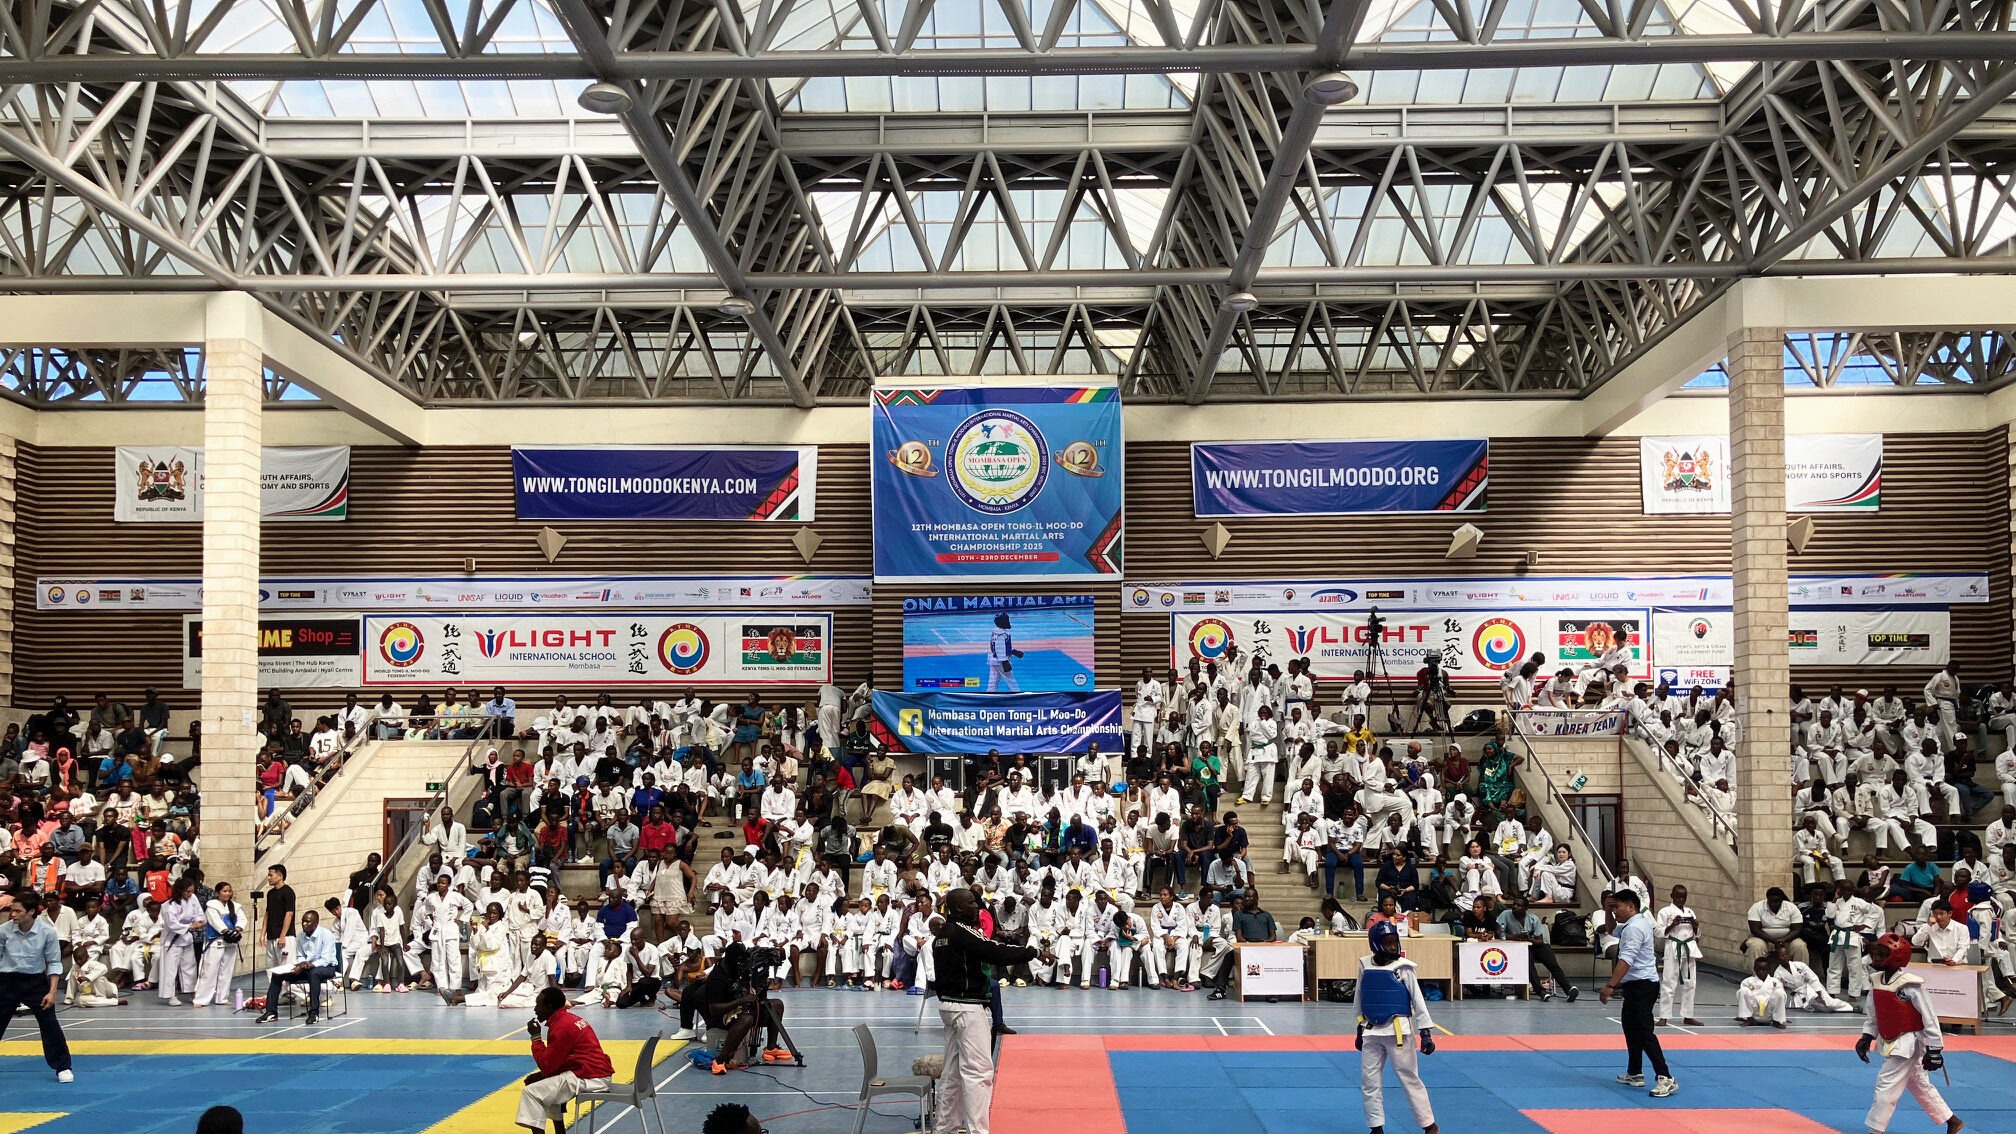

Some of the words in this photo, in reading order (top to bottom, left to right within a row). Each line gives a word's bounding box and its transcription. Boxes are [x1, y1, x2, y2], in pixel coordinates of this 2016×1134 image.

[968, 456, 1005, 464] MOMBASA
[280, 474, 314, 482] AFFAIRS,
[1206, 466, 1439, 489] WWW.TONGILMOODO.ORG
[298, 482, 330, 490] SPORTS
[522, 477, 757, 494] WWW.TONGILMOODOKENYA.COM
[1008, 522, 1043, 530] TONG-IL
[1042, 532, 1064, 540] ARTS
[963, 596, 1047, 609] MARTIAL
[258, 630, 292, 648] IME
[299, 628, 334, 645] Shop
[509, 630, 616, 647] LIGHT
[1322, 626, 1430, 643] LIGHT
[1870, 634, 1886, 642] TOP
[509, 652, 577, 660] INTERNATIONAL
[579, 652, 616, 660] SCHOOL
[1322, 648, 1390, 657] INTERNATIONAL
[928, 709, 976, 720] Mombasa
[980, 710, 1005, 722] Open
[1008, 710, 1047, 722] Tong-IL
[1050, 708, 1086, 720] Moo-Do
[929, 725, 994, 736] International
[999, 725, 1033, 736] Martial
[1036, 726, 1058, 736] Arts
[1060, 722, 1122, 736] Championship
[1555, 722, 1589, 735] KOREA
[1592, 716, 1618, 732] TEAM
[317, 739, 331, 753] 15
